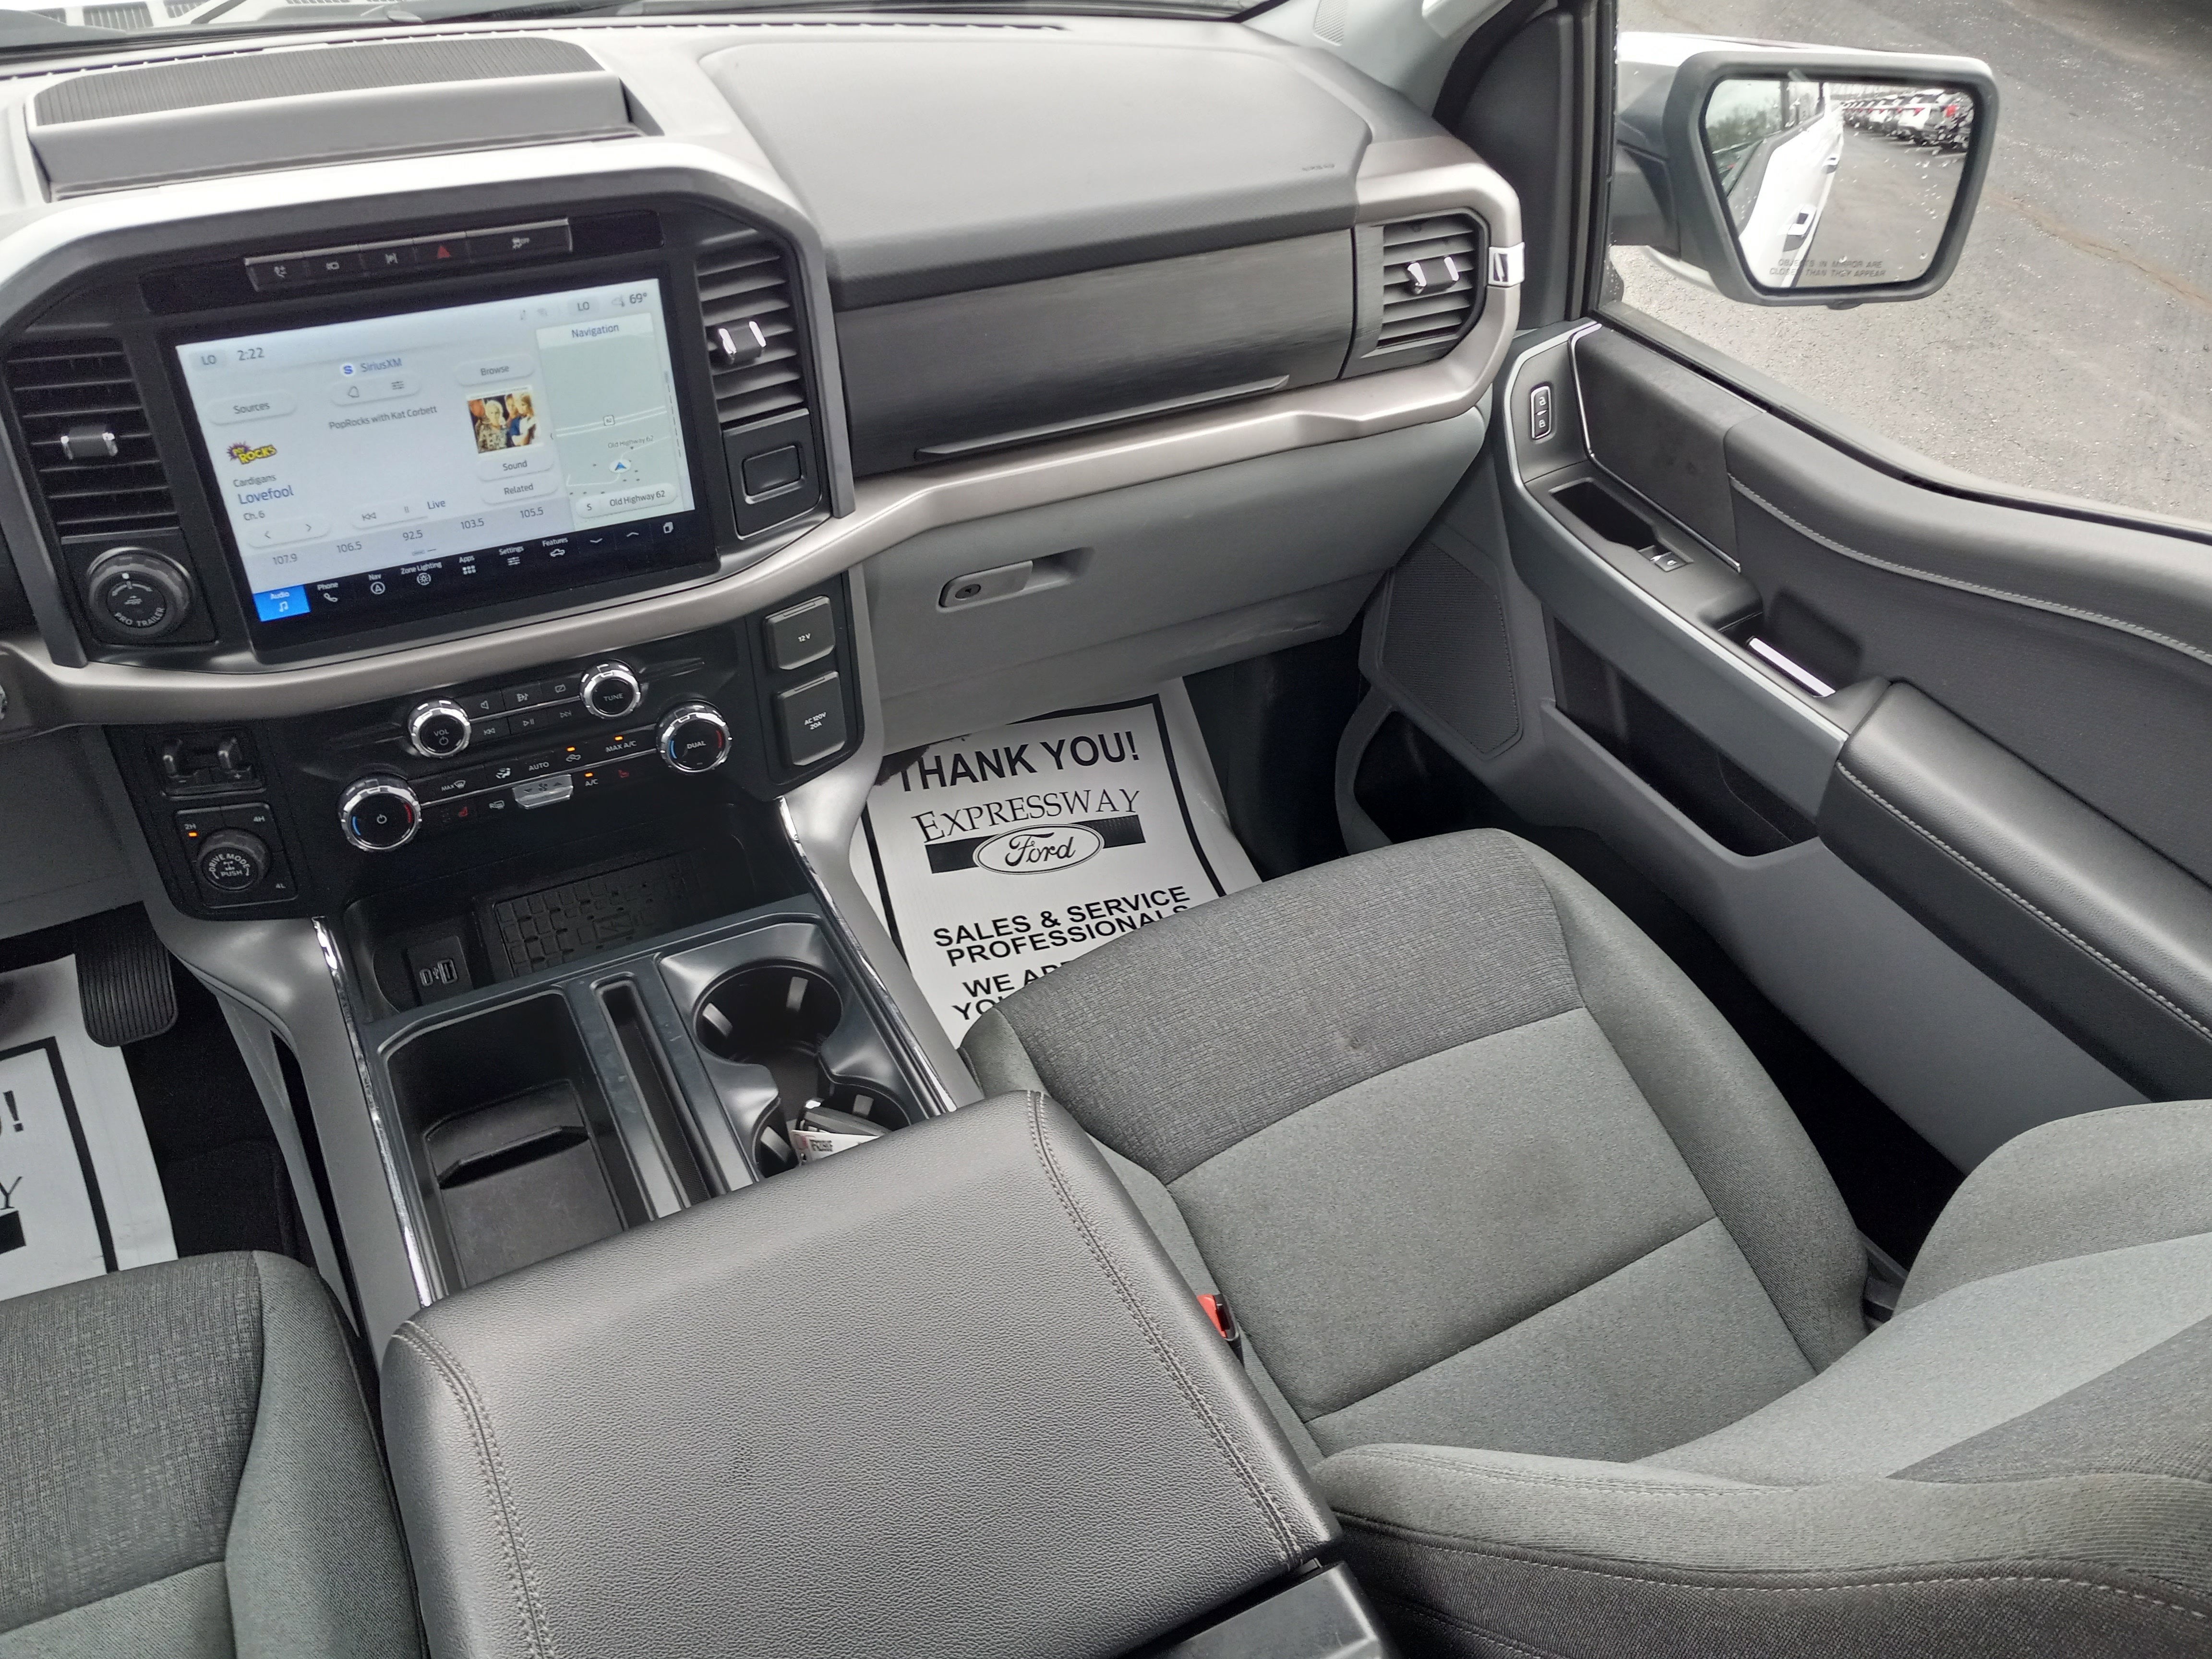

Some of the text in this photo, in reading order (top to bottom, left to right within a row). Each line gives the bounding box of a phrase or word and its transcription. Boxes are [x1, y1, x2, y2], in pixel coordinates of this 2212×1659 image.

[629, 292, 648, 304] 69°
[577, 301, 590, 311] LO
[572, 323, 619, 338] Navigation
[201, 354, 216, 366] LO
[238, 348, 264, 361] 2:22
[361, 358, 402, 373] SiriusXM
[481, 364, 510, 376] Browse
[233, 402, 270, 415] Sources
[329, 406, 437, 429] PopRocks with Kat Corbett
[619, 438, 645, 446] Highway
[239, 445, 277, 465] ROCKS
[503, 459, 527, 471] Sound
[233, 475, 276, 487] Cardigans
[238, 484, 294, 505] Lovefool
[504, 482, 534, 495] Related
[427, 498, 446, 510] Live
[587, 490, 665, 511] S Old Highway 62
[243, 510, 265, 521] Ch. 6
[520, 506, 544, 518] 105.5
[460, 517, 484, 530] 103.5
[402, 529, 423, 541] 92.5
[337, 541, 362, 553] 106.5
[542, 536, 568, 547] Features
[499, 545, 524, 556] Settings
[272, 553, 298, 566] 107.9
[459, 555, 475, 563] Apps
[417, 562, 442, 571] Lighting
[368, 573, 382, 581] Nav
[317, 581, 338, 591] Phone
[270, 591, 290, 600] Audio
[114, 607, 165, 627] PRO TRAILER
[798, 633, 811, 643] 12V
[603, 692, 624, 701] TUNE
[804, 718, 813, 726] AC
[810, 721, 822, 730] 20A
[433, 729, 450, 737] VOL
[686, 740, 706, 750] DUAL
[1040, 731, 1141, 771] YOU!
[529, 740, 637, 771] AUTO MAX A/C
[441, 784, 455, 792] MAX
[585, 778, 599, 787] A/C
[912, 789, 1141, 843] EXPRESSWAY
[1004, 831, 1077, 867] Ford
[209, 853, 251, 873] DRIVE MODE
[220, 869, 242, 878] PUSH
[933, 886, 1190, 948] SALES & SERVICE
[962, 974, 1015, 998] WE
[951, 996, 1004, 1021] YO
